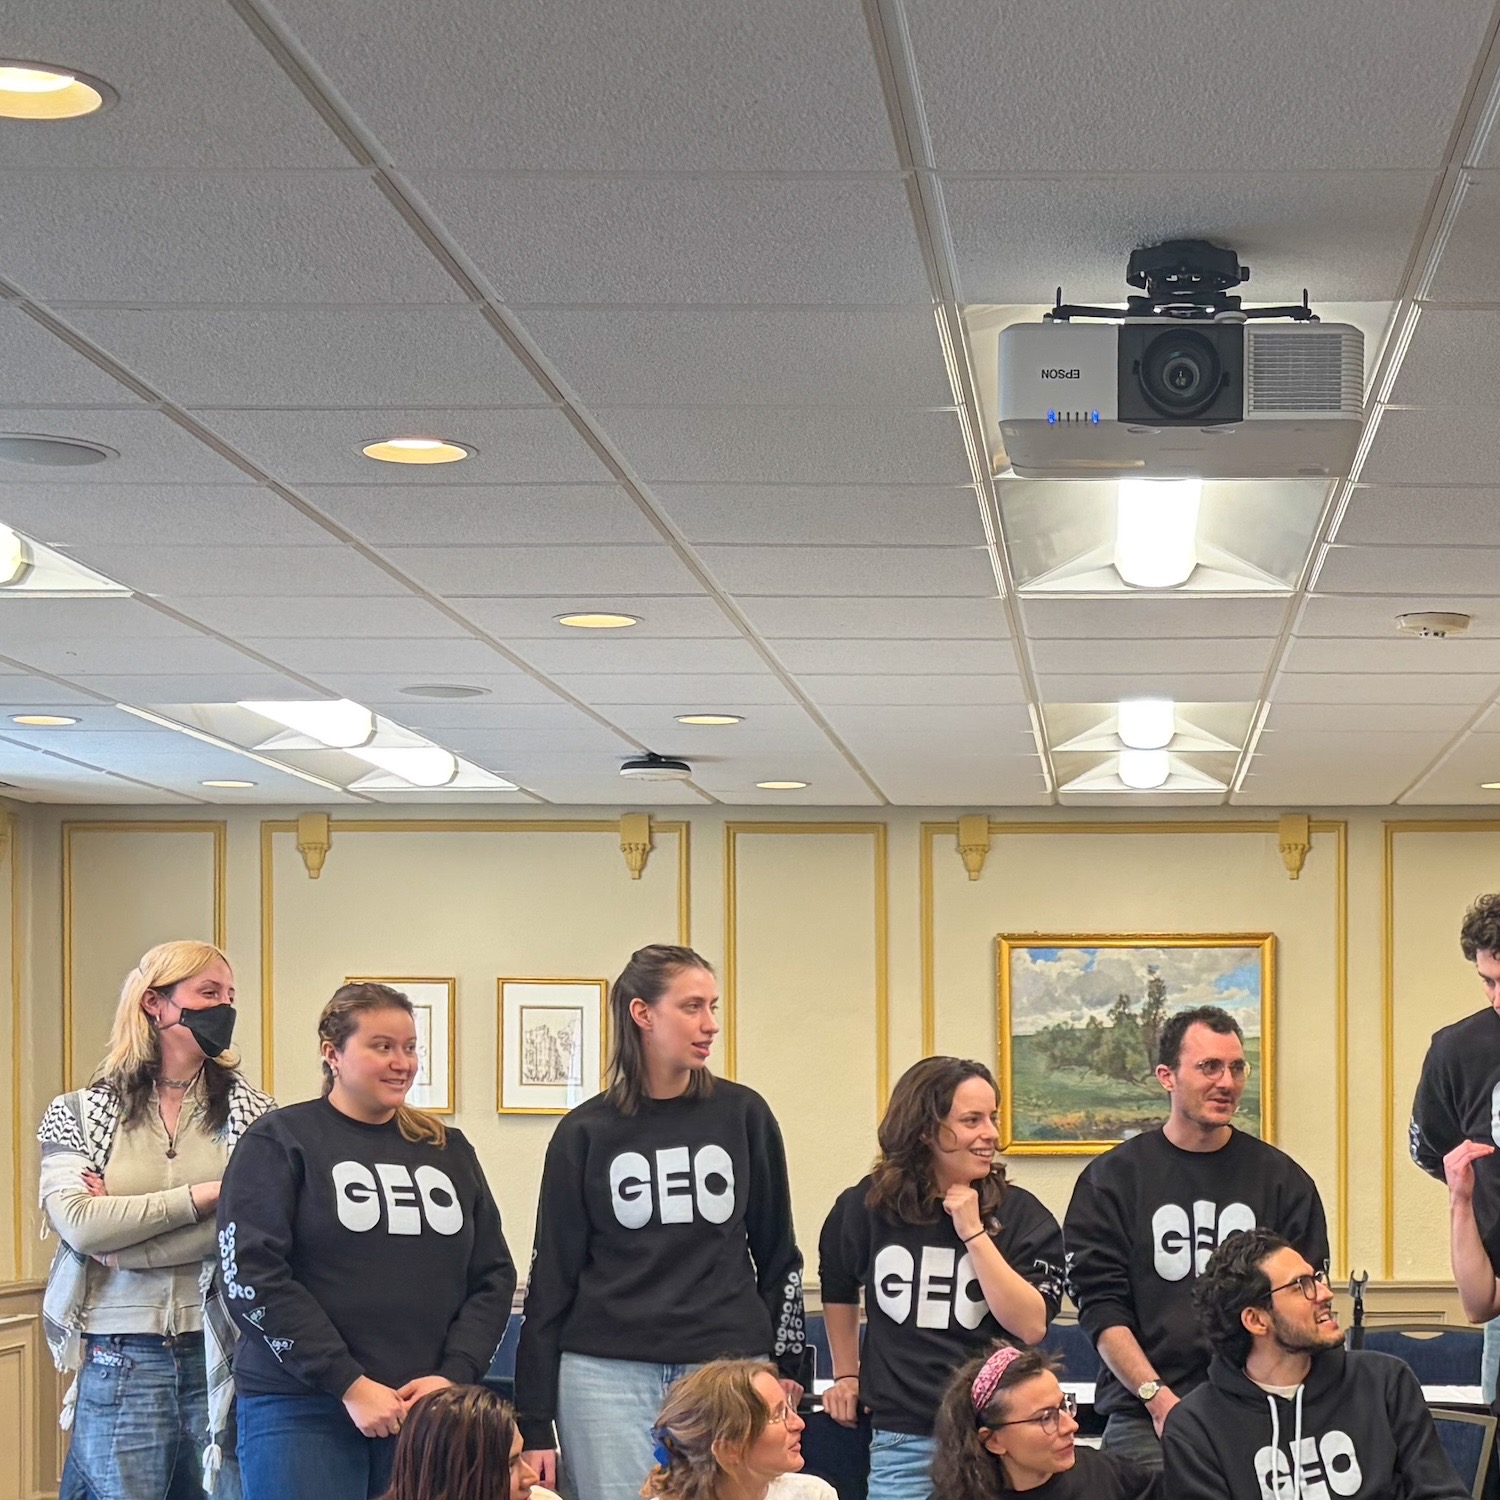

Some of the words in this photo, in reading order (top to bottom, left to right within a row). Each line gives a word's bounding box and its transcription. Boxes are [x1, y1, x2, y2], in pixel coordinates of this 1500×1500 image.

[1041, 369, 1080, 379] EPSON
[331, 1161, 464, 1235] GEO
[609, 1145, 735, 1229] GEO
